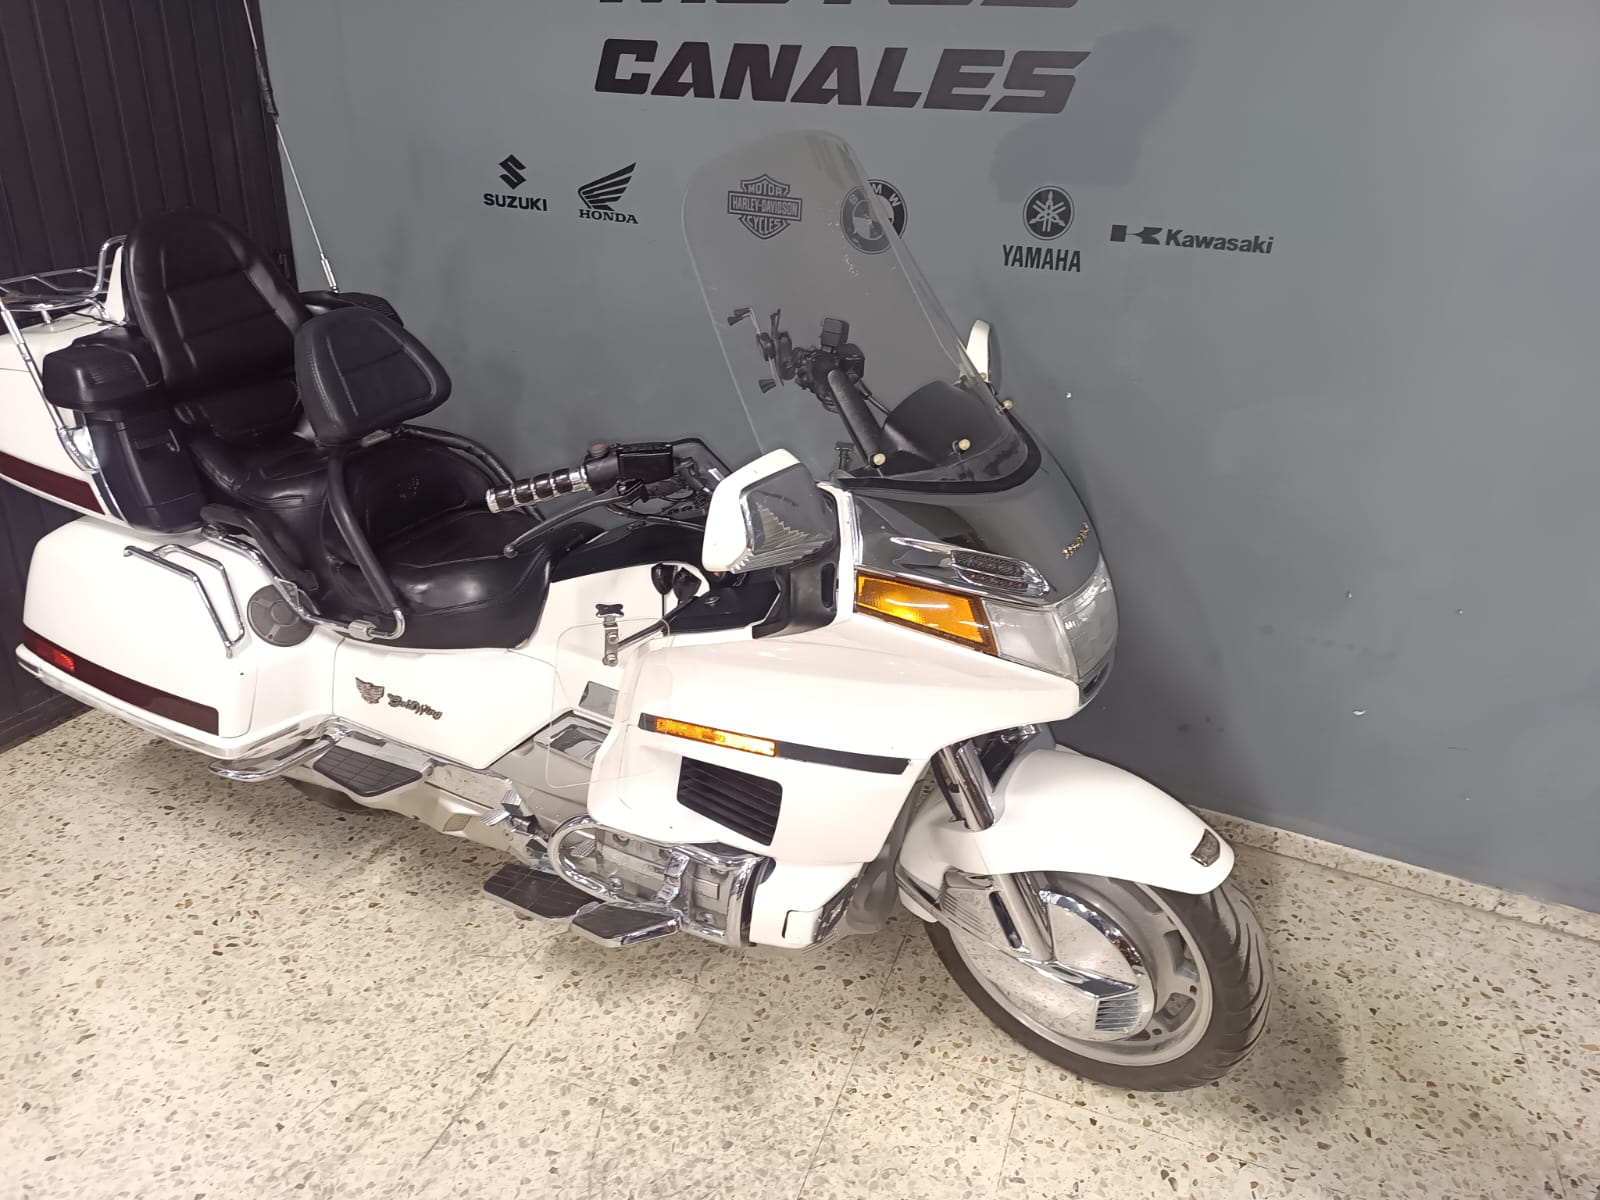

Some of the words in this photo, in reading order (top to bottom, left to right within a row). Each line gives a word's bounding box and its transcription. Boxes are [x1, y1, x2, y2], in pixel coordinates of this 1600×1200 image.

[594, 38, 1092, 114] CANALES
[748, 183, 784, 196] MOTOR
[483, 193, 548, 212] SUZUKI
[732, 196, 799, 216] HARLEY-DAVIDSON
[578, 209, 639, 224] HONDA
[748, 216, 782, 234] CYCLES
[1165, 228, 1275, 254] Kawasaki
[1002, 244, 1081, 273] YAMAHA
